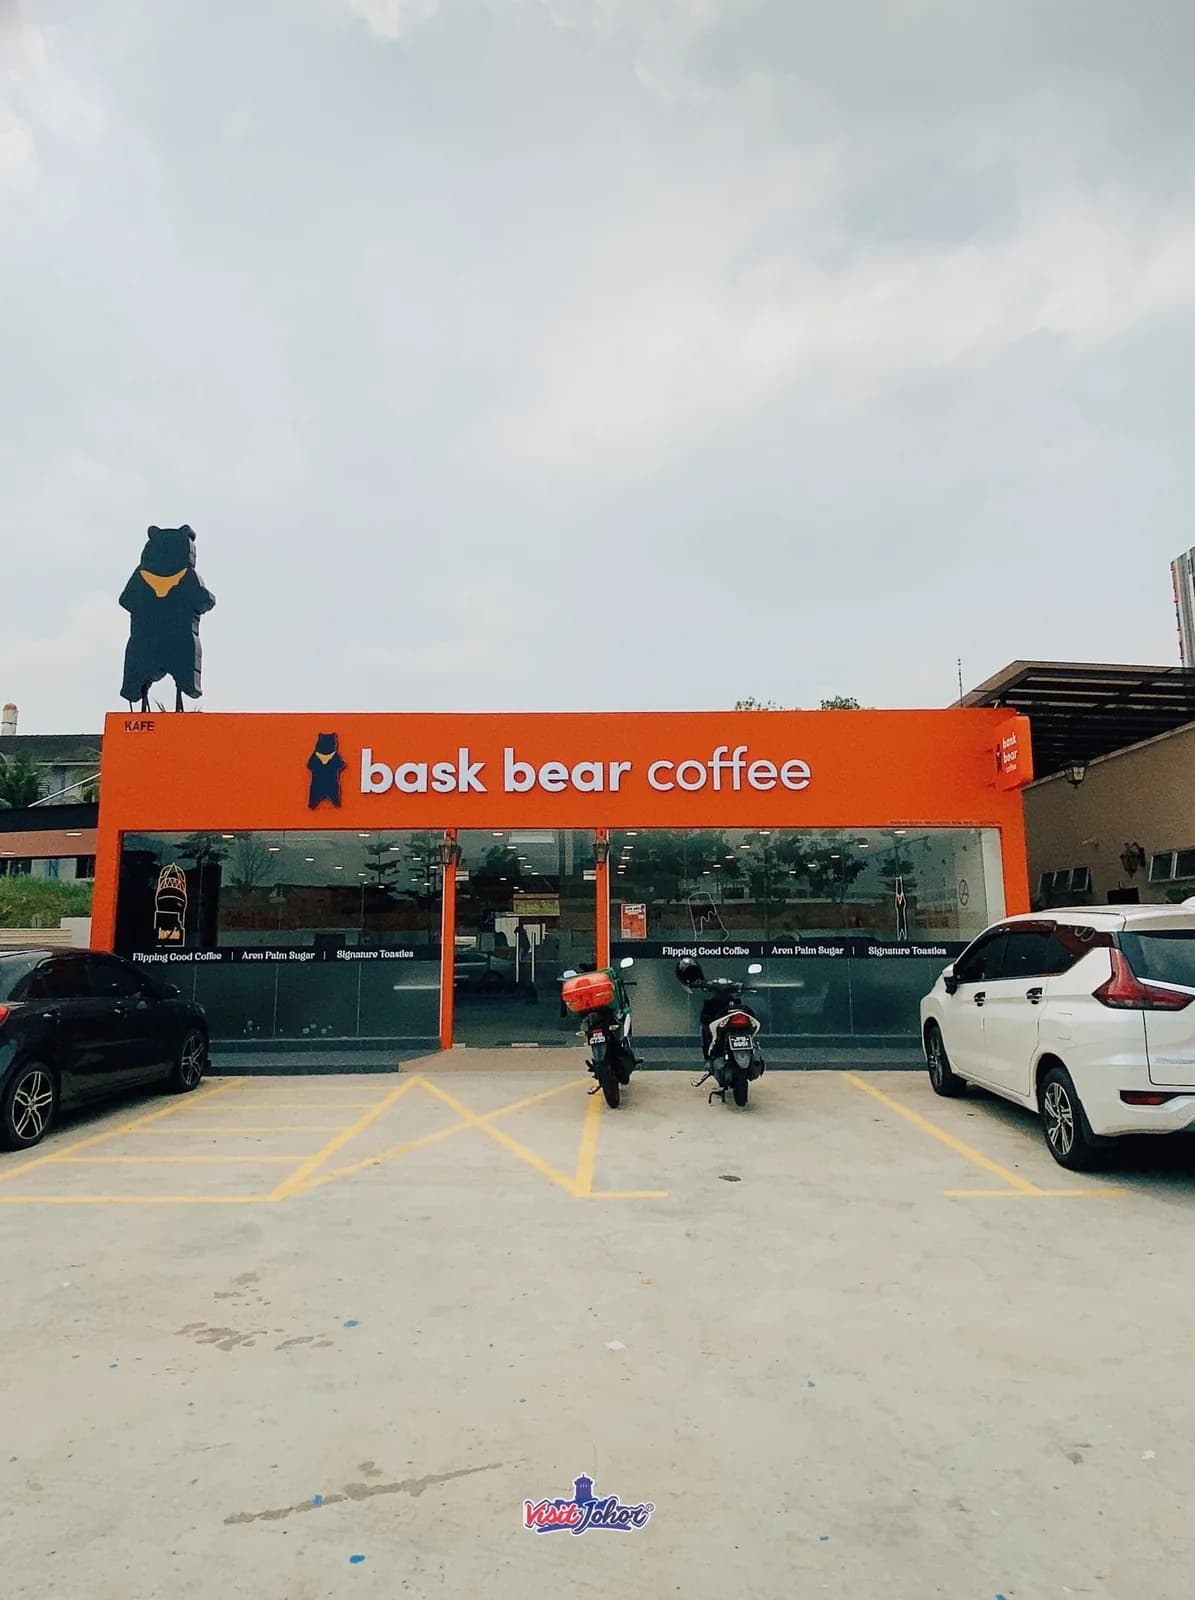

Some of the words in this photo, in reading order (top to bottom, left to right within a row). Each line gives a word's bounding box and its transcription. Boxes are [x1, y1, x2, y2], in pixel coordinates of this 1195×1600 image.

[125, 721, 155, 731] KAFE
[1002, 731, 1017, 749] bask
[1003, 750, 1018, 764] bear
[360, 747, 488, 793] bask
[503, 747, 632, 793] bear
[648, 745, 812, 792] coffee
[242, 951, 264, 960] Aren
[265, 951, 287, 960] Palm
[289, 951, 315, 961] Sugar
[336, 950, 378, 960] Signature
[379, 949, 414, 959] Toasties
[662, 946, 697, 957] Flipping
[699, 947, 721, 955] Good
[722, 946, 750, 955] Coffee
[771, 946, 793, 955] Aren
[795, 946, 816, 955] Palm
[818, 945, 845, 956] Sugar
[868, 946, 910, 957] Signature
[911, 946, 947, 955] Toasties
[132, 952, 168, 963] Flipping
[169, 953, 193, 961] Good
[194, 952, 222, 961] Coffee
